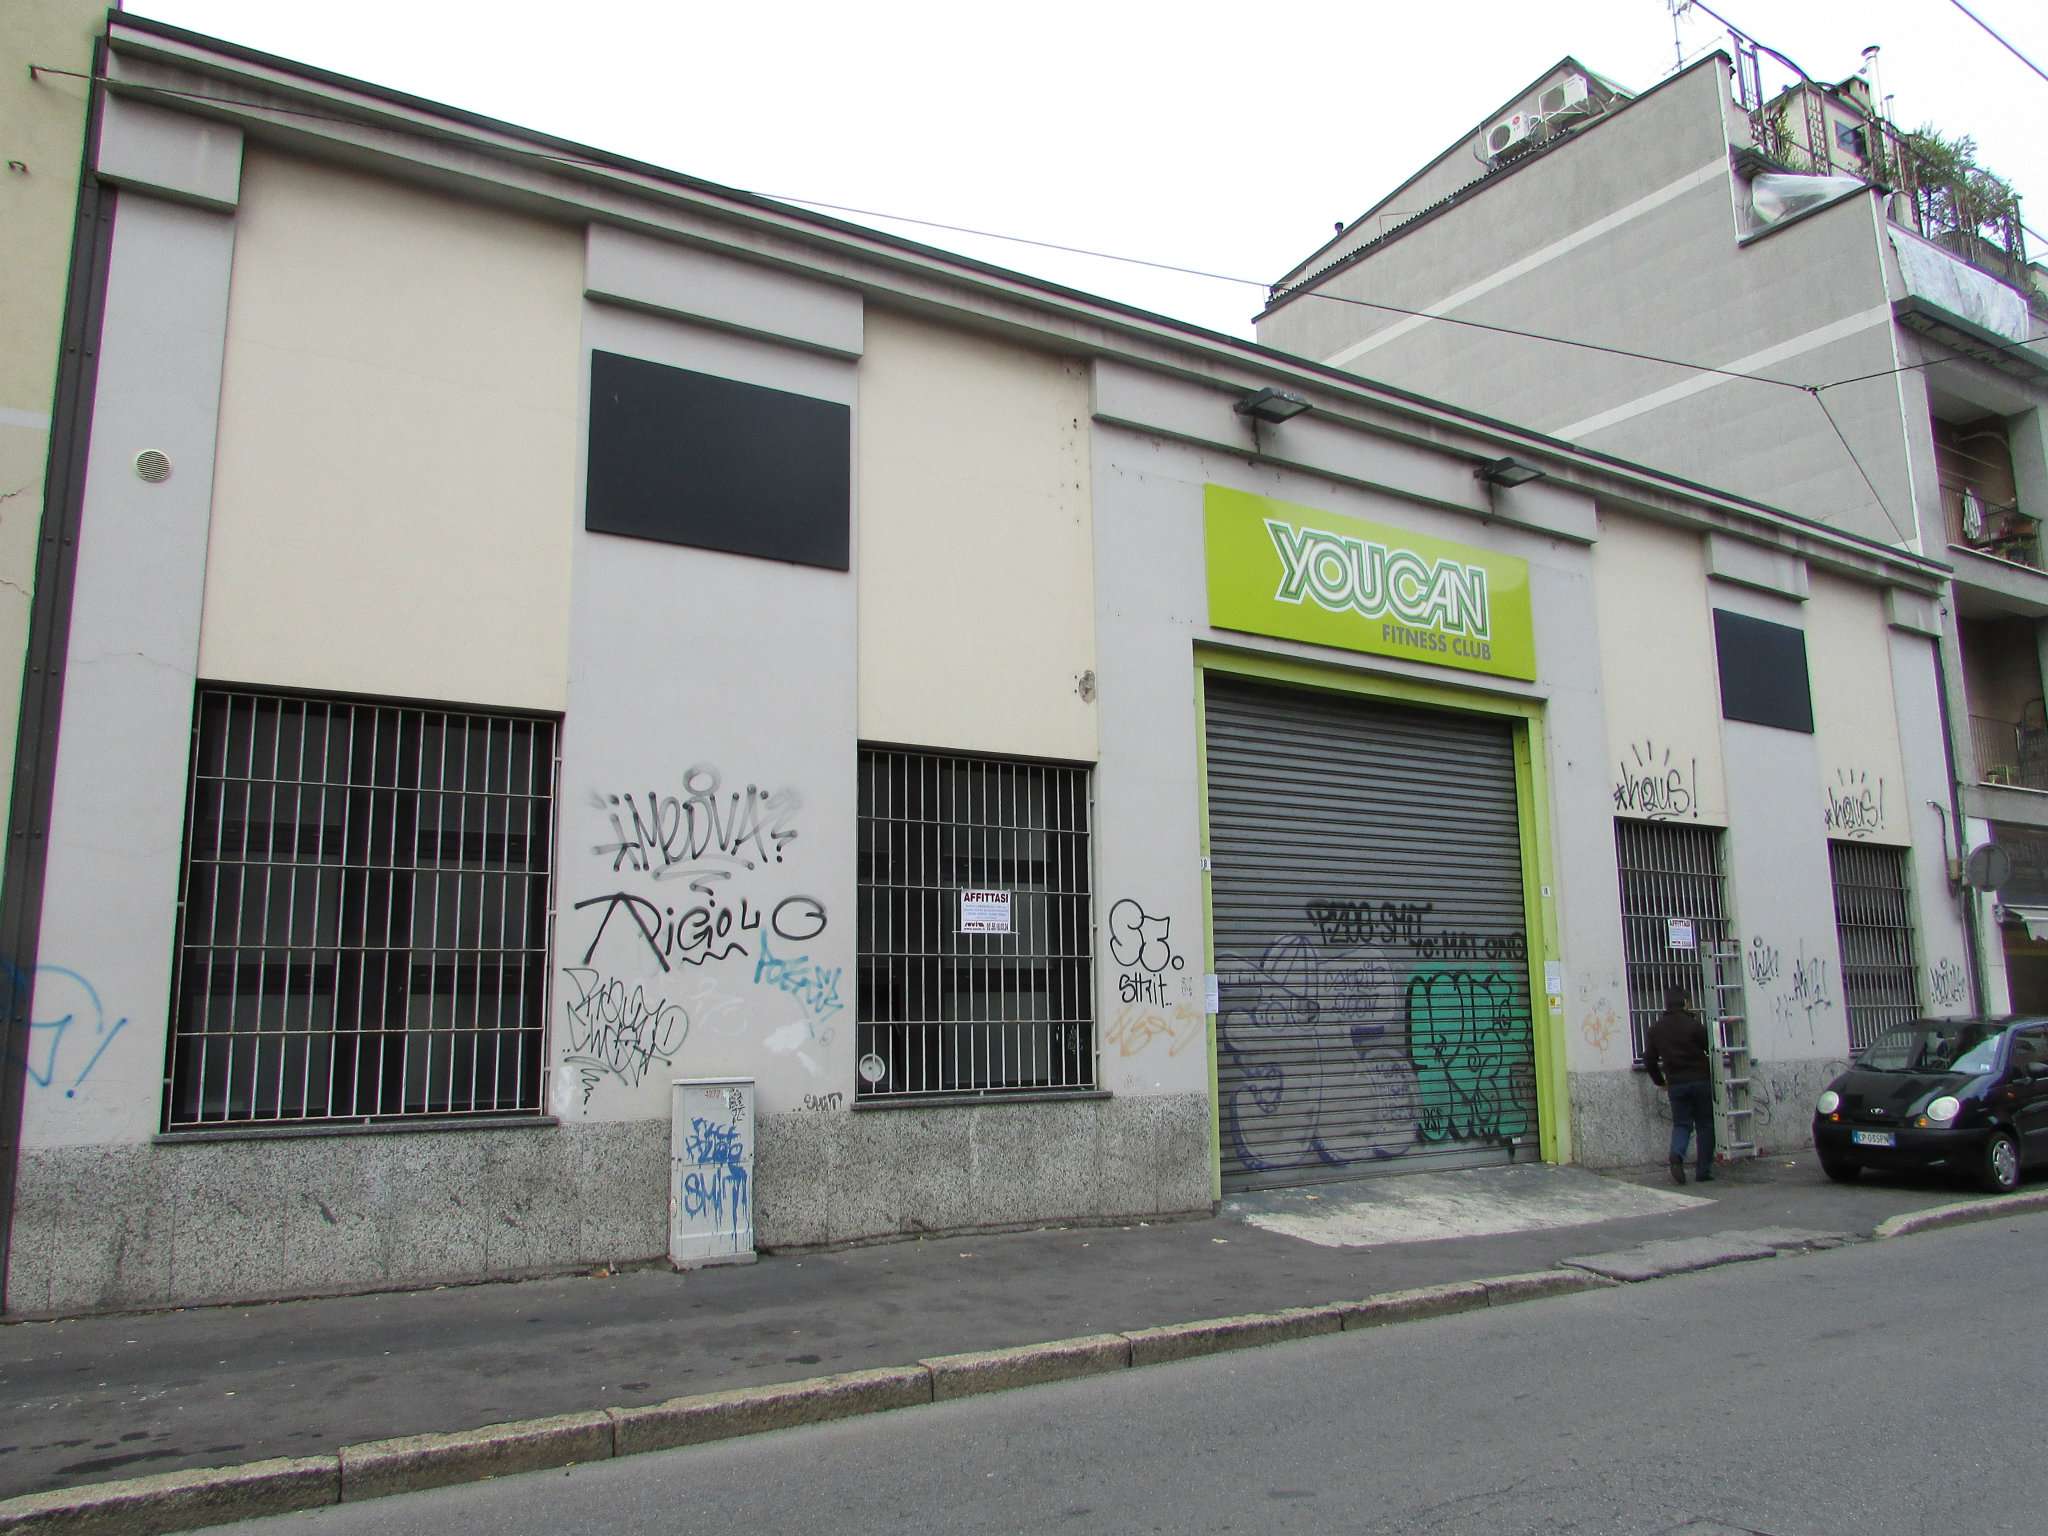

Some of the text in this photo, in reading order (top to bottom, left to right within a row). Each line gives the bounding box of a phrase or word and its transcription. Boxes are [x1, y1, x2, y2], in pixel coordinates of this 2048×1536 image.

[1382, 623, 1492, 661] FITNESS CLUB
[963, 892, 1009, 903] AFFITTASI
